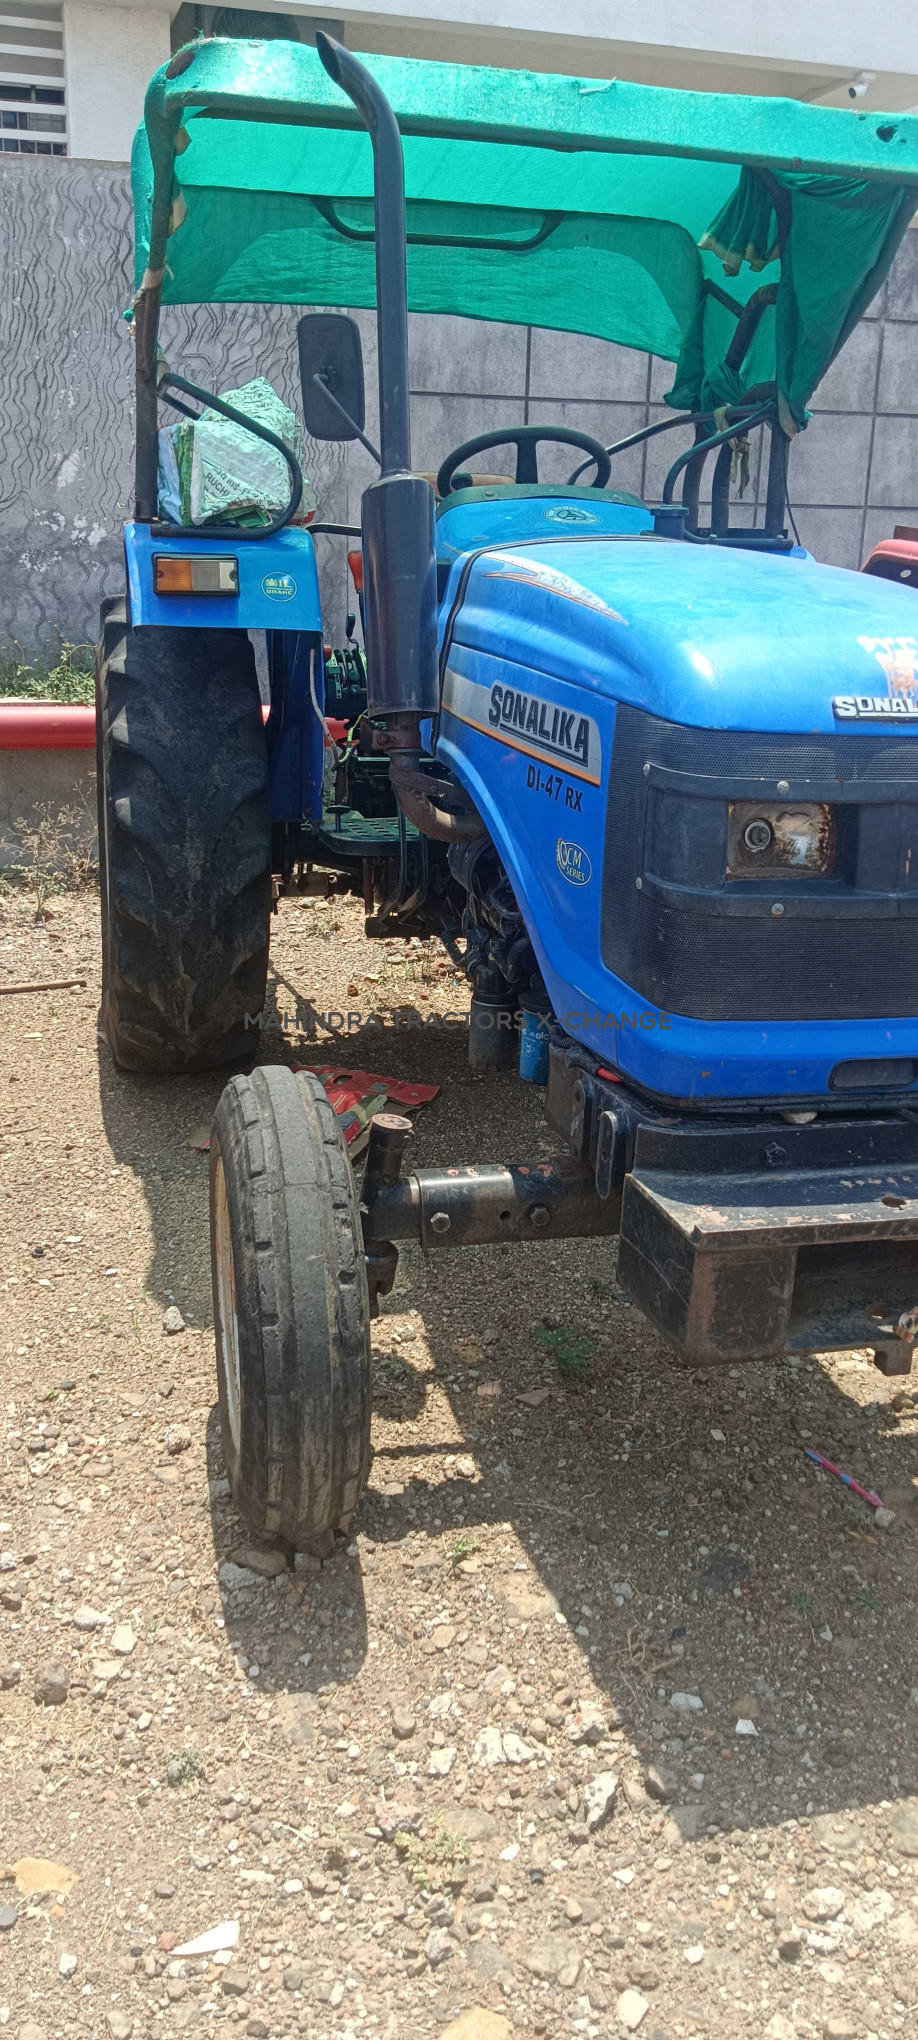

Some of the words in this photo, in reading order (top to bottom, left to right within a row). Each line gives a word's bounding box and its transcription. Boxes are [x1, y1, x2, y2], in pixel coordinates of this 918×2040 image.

[266, 579, 292, 587] OIL
[489, 685, 590, 767] SONALIKA
[526, 764, 563, 802] DI-47
[565, 786, 583, 813] RX
[566, 866, 585, 882] SERIES
